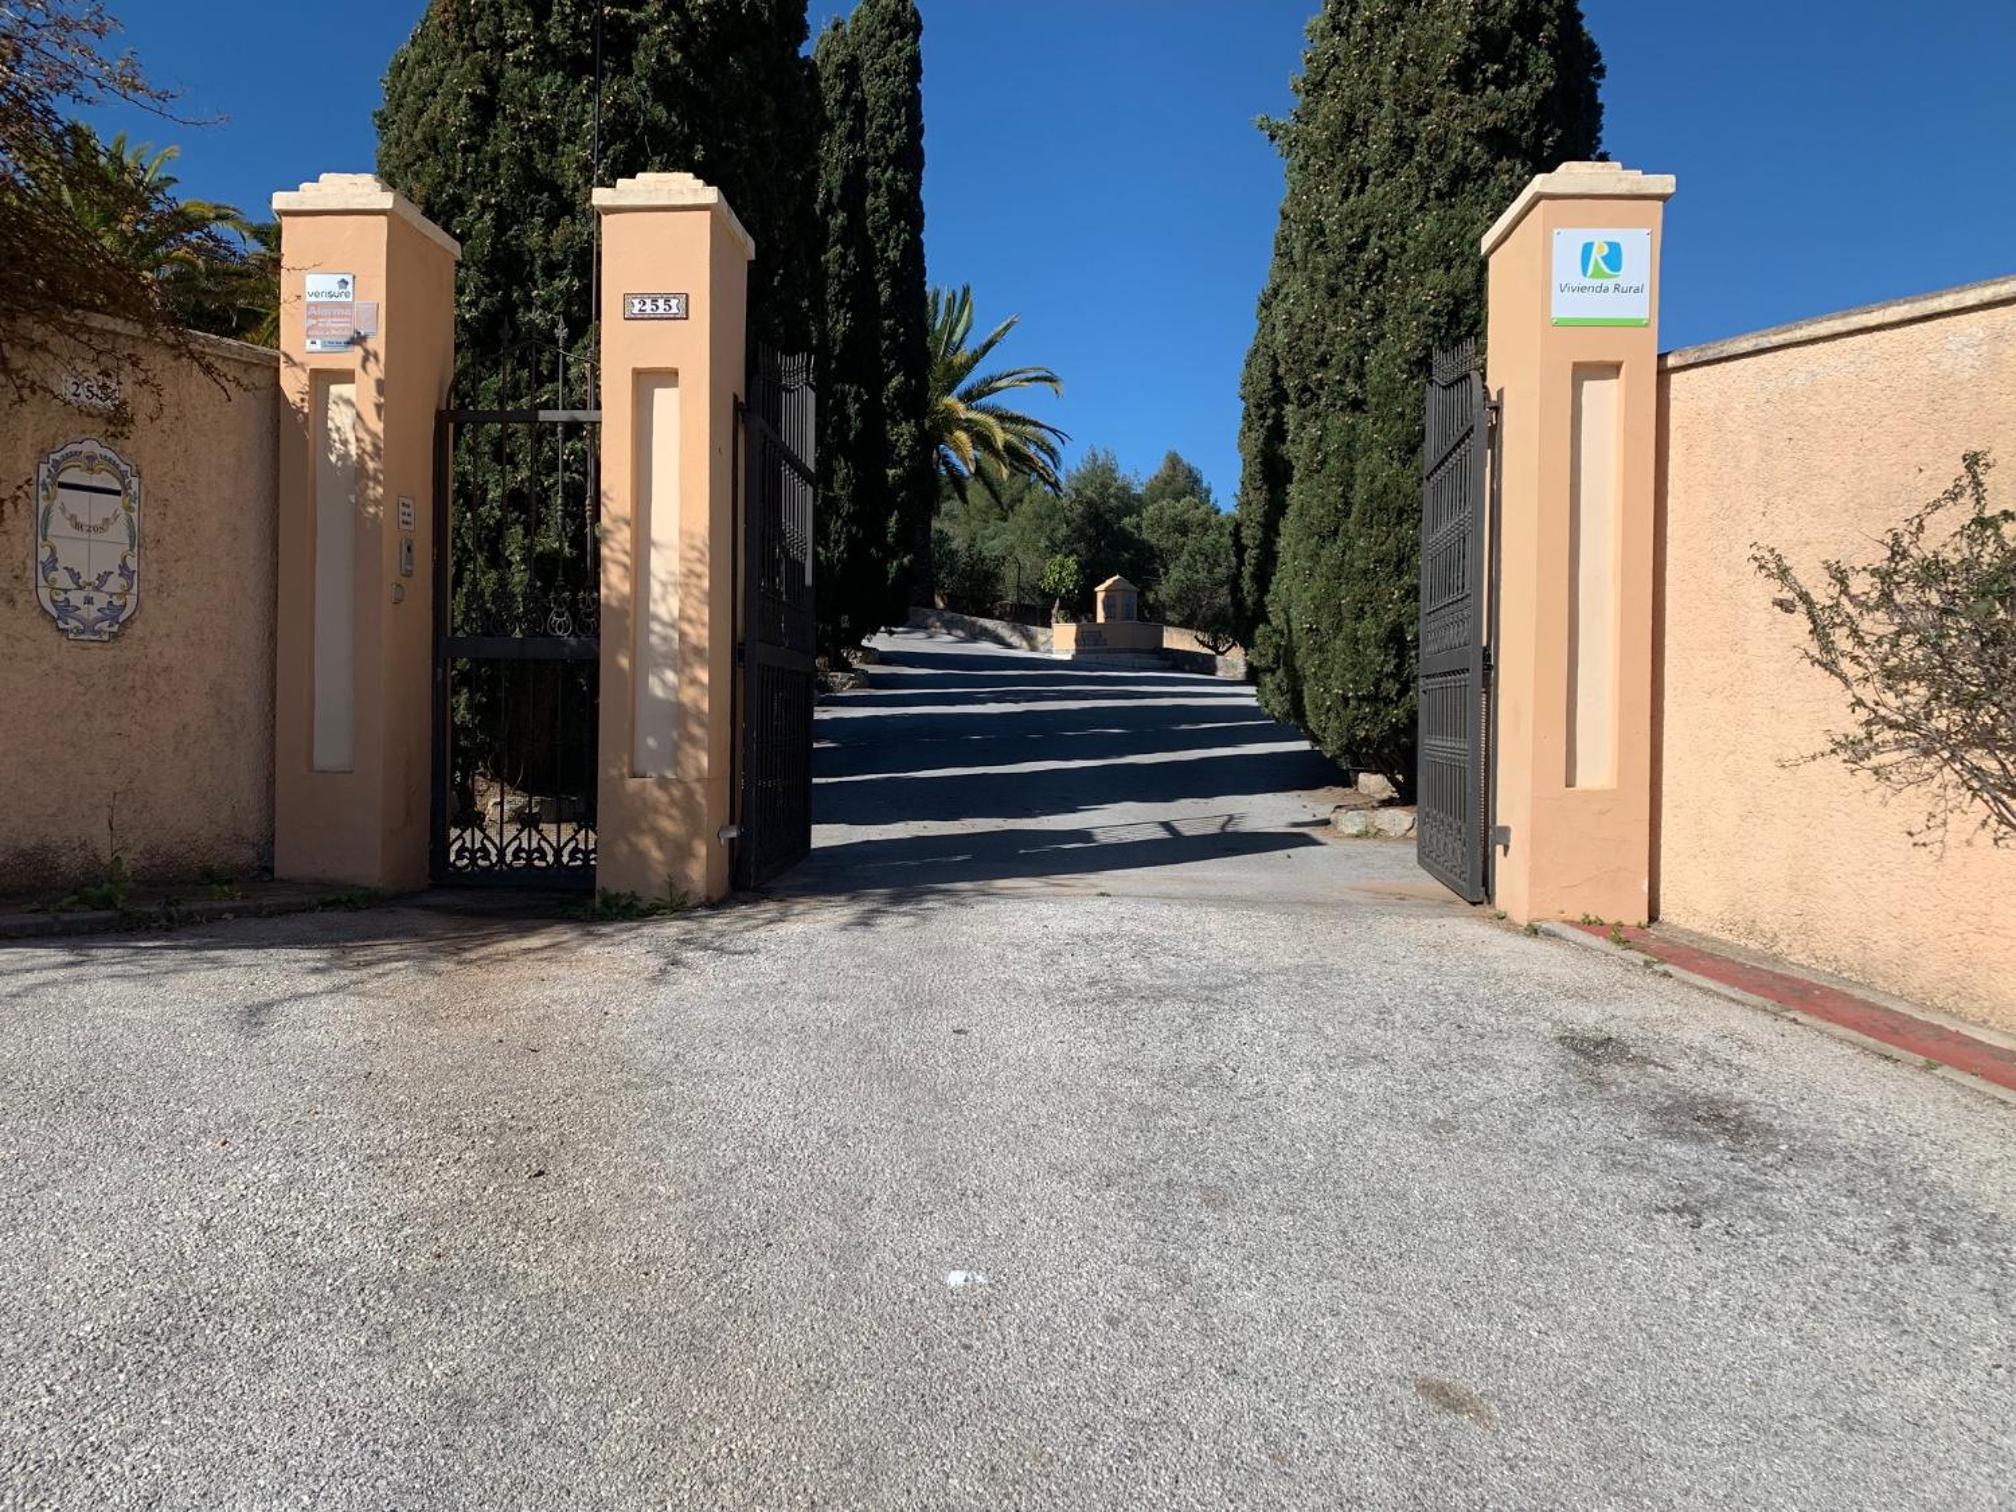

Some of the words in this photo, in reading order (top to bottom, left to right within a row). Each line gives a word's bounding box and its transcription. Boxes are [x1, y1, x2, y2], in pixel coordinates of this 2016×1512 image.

[1559, 283, 1609, 294] Vivienda
[1613, 283, 1645, 294] Rural
[307, 290, 351, 299] verisure
[638, 299, 672, 312] 255
